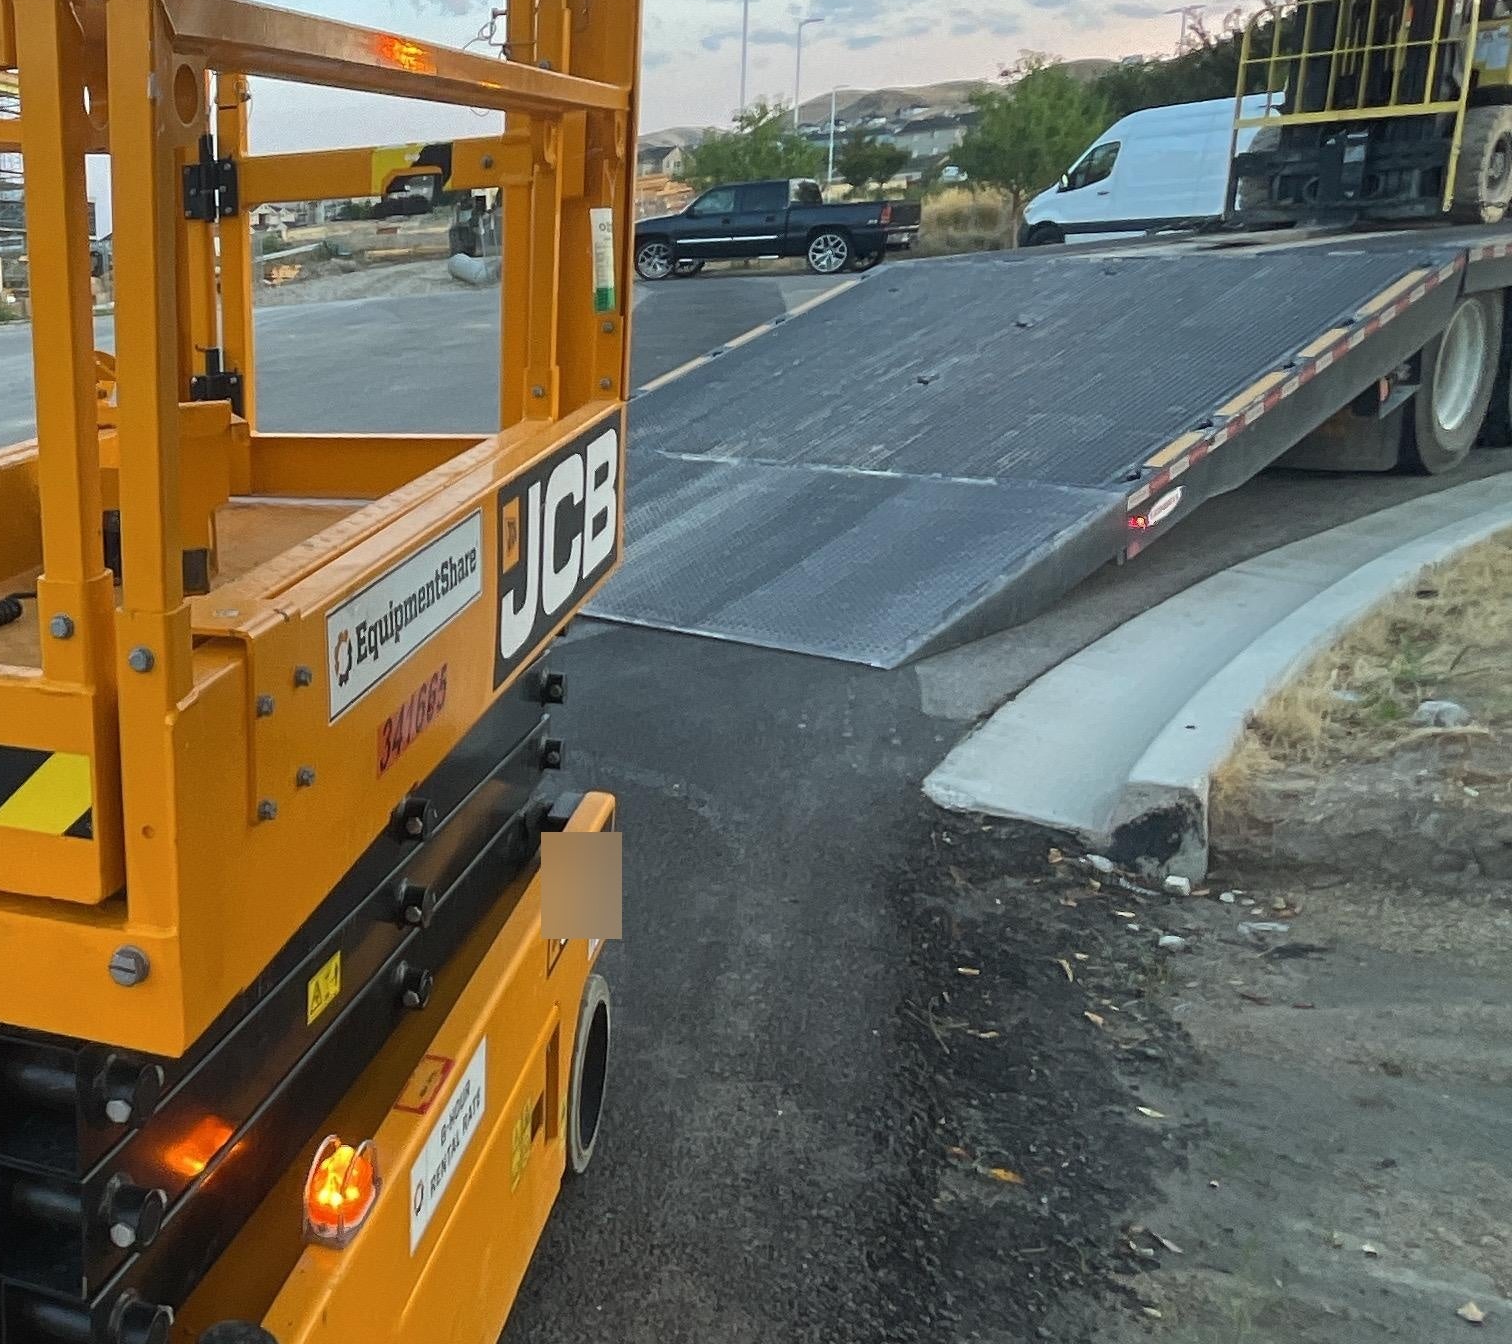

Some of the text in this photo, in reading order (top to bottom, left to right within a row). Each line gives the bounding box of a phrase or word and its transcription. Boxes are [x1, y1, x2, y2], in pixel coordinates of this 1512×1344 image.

[500, 427, 619, 660] JCB
[355, 546, 478, 665] EquipmentShare
[379, 662, 448, 772] 341665
[429, 1086, 481, 1198] RENTAL RATE
